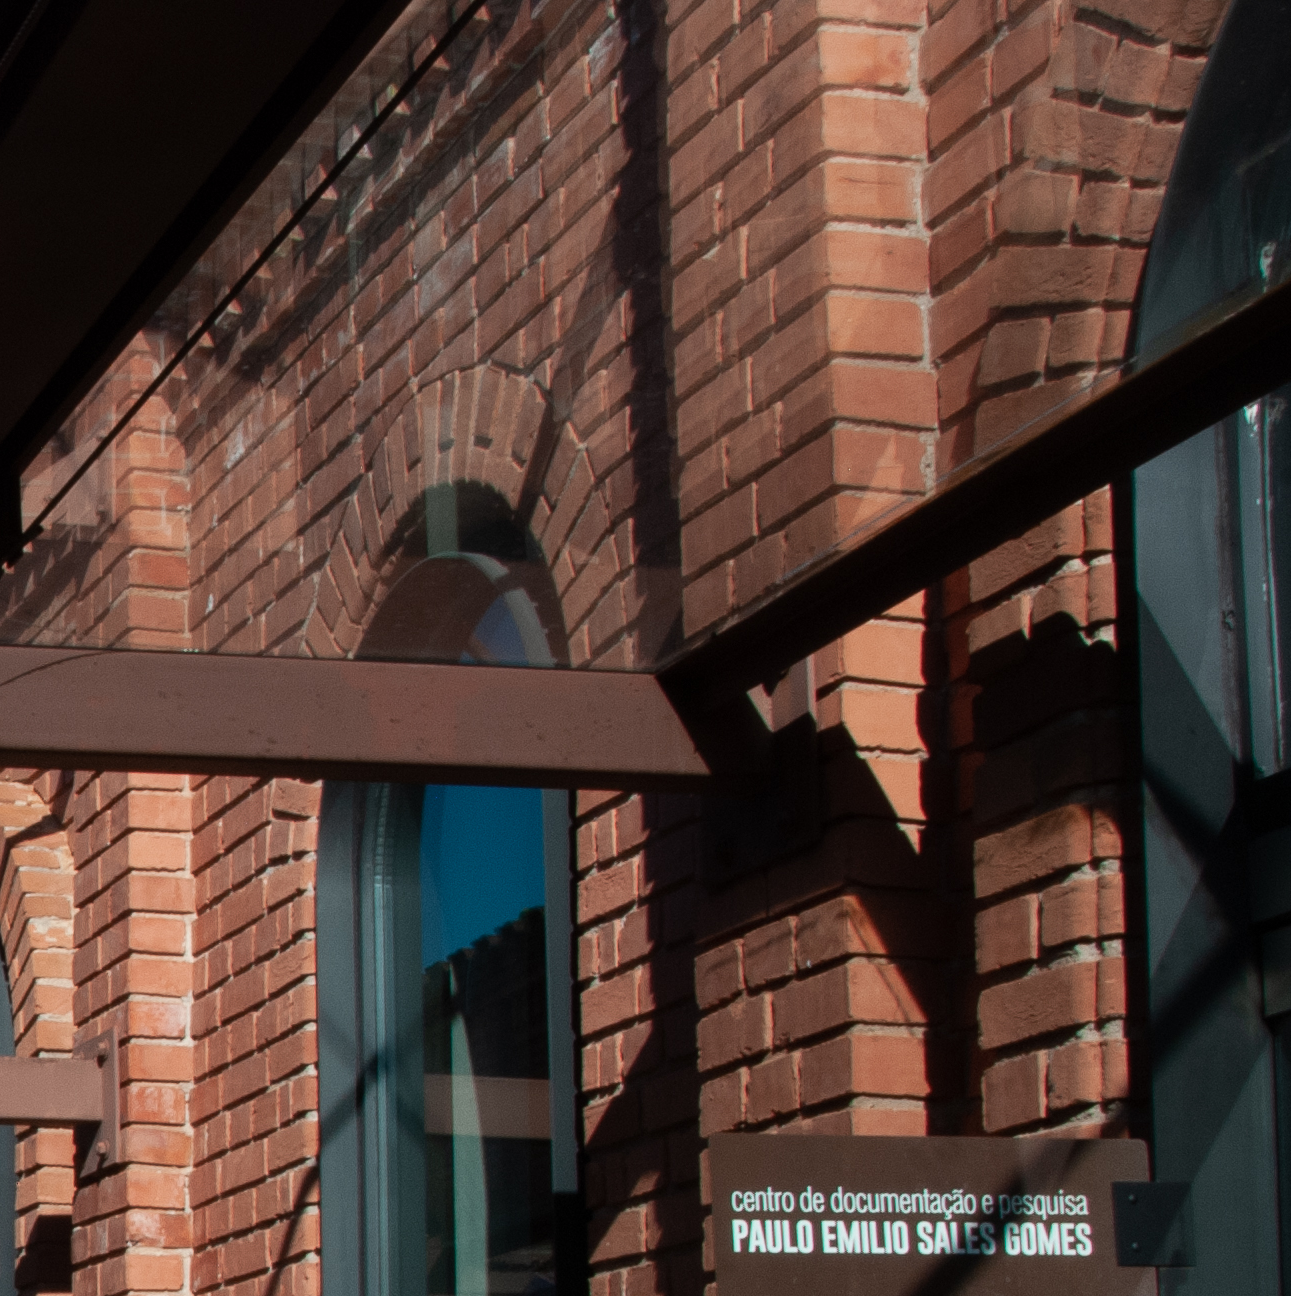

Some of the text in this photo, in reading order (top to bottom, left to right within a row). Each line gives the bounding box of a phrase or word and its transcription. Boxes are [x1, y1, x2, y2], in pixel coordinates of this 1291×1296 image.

[731, 1185, 1089, 1221] centro de documentação e pesquisa
[731, 1219, 1093, 1257] PAULO EMILIO SALES GOMES
